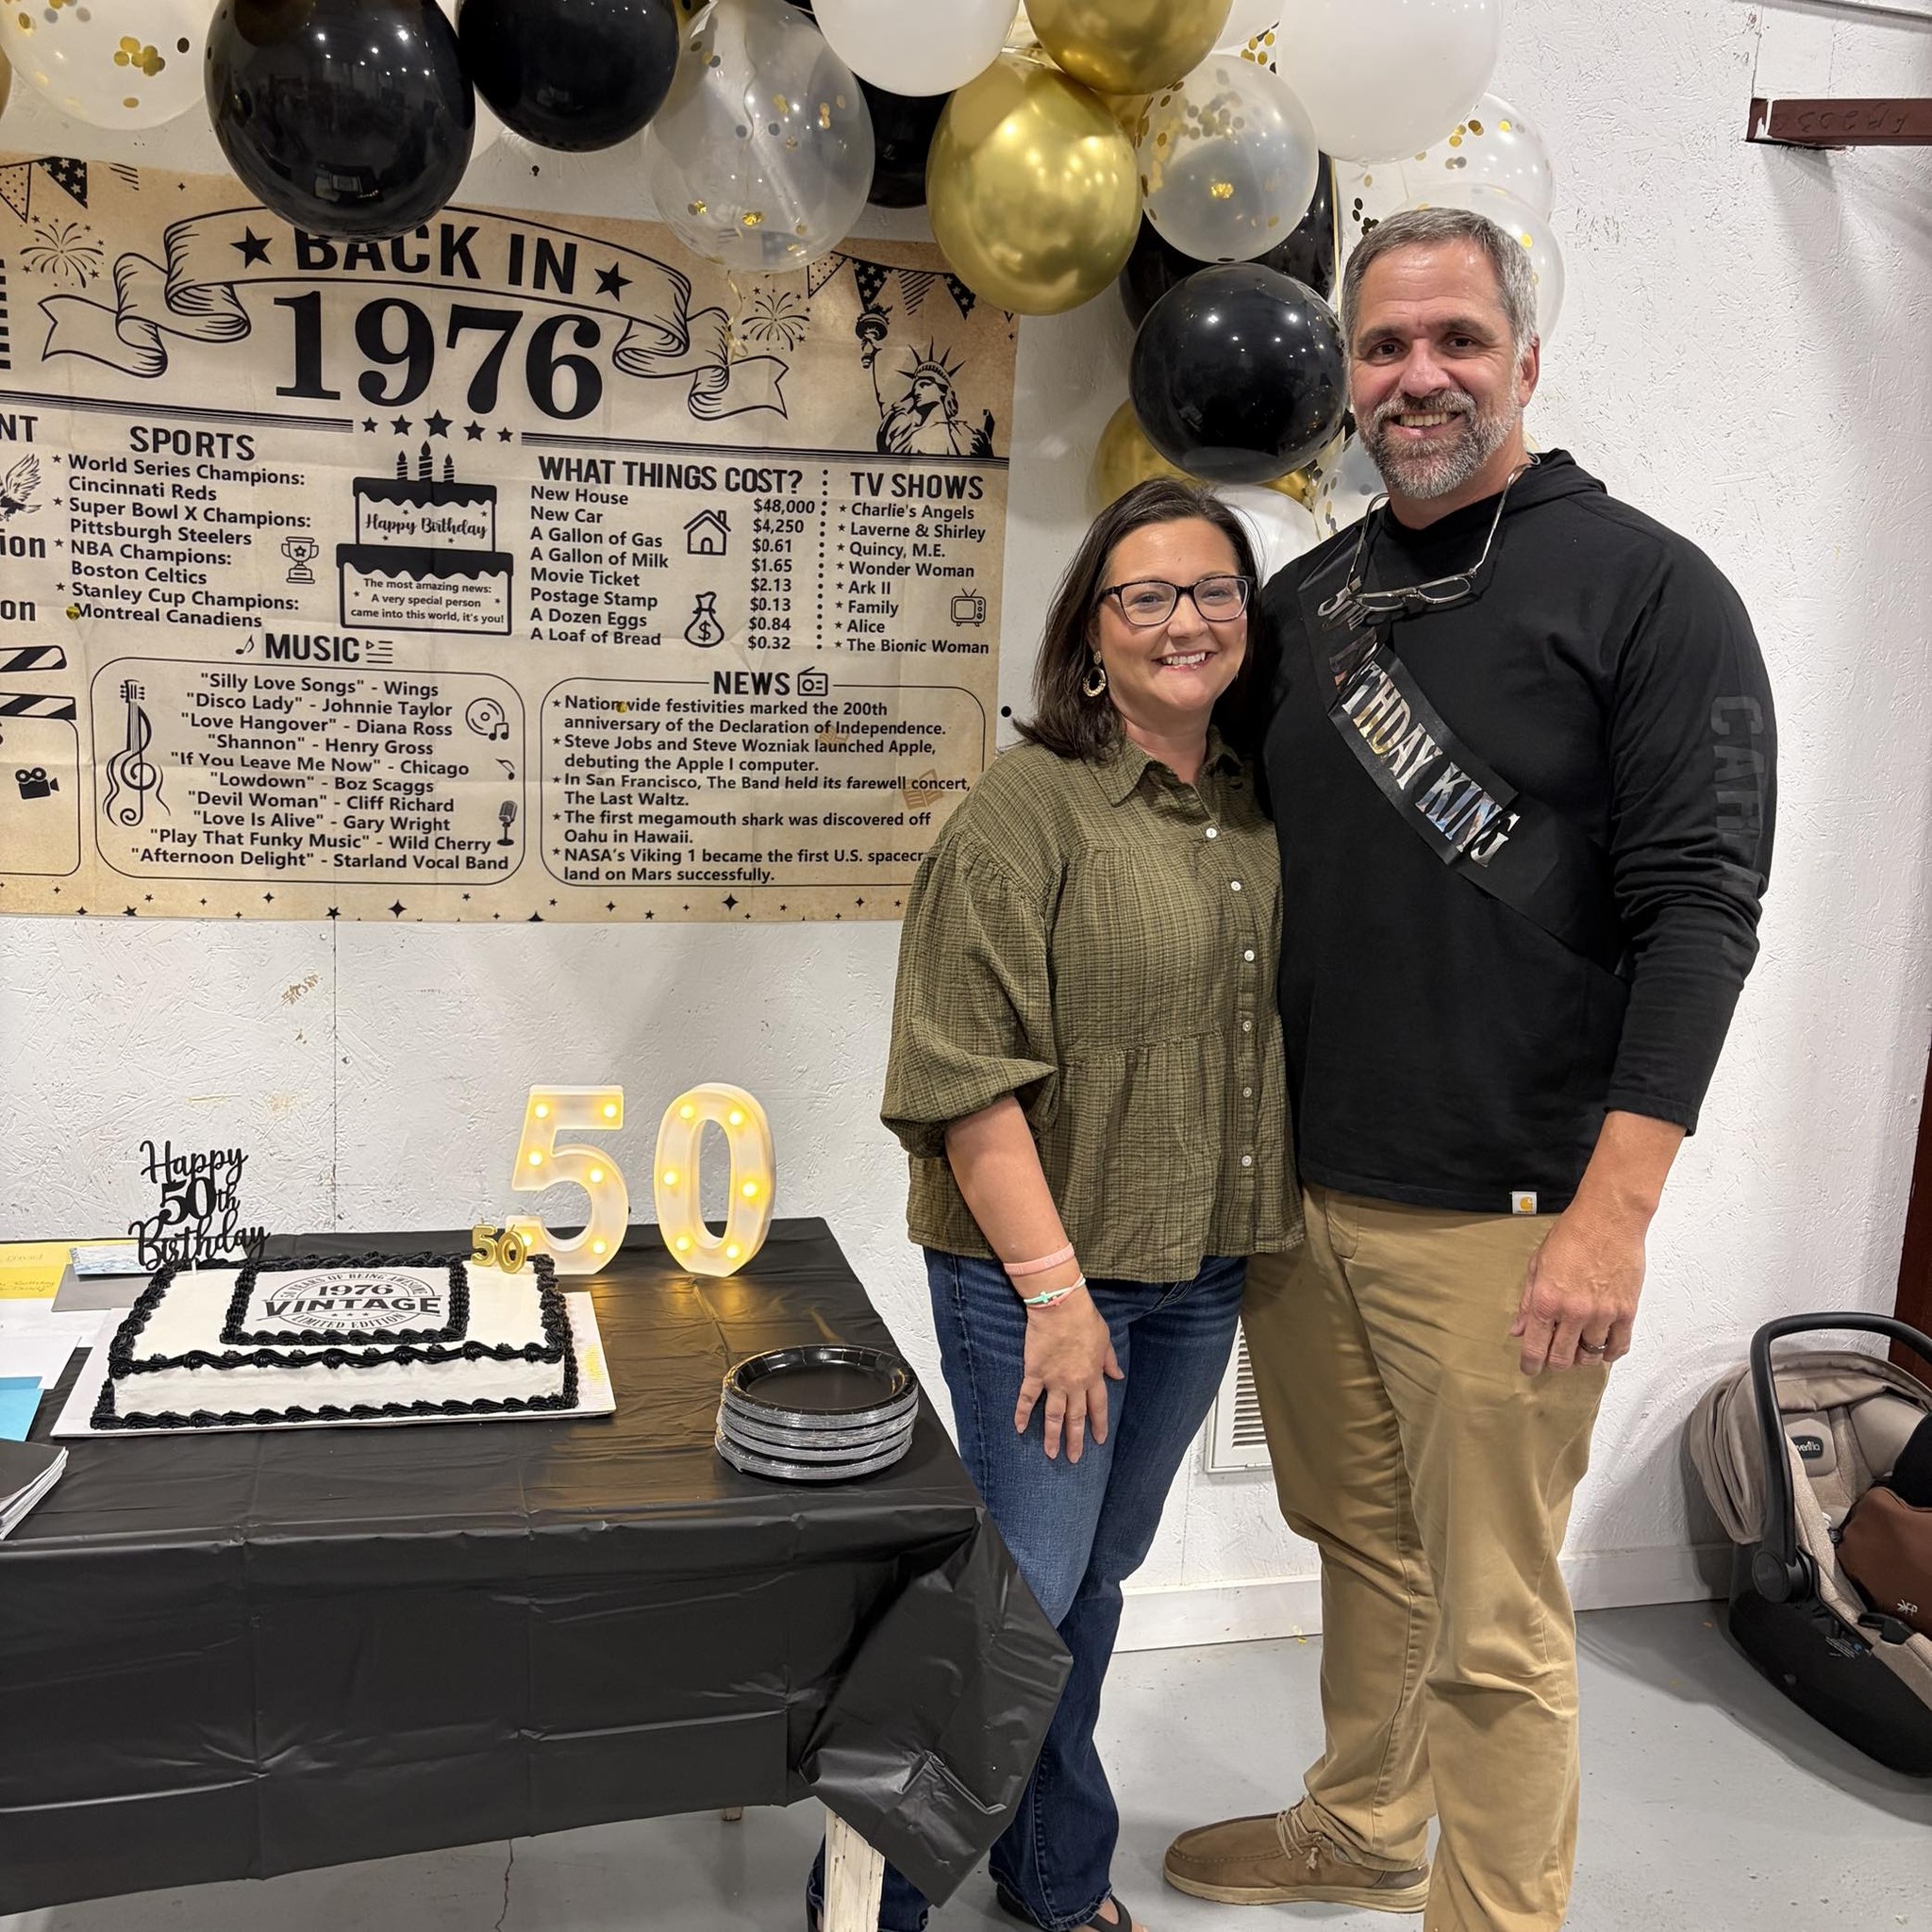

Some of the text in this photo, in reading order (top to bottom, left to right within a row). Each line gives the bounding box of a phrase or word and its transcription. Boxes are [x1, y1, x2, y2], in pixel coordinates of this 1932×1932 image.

[293, 223, 578, 295] BACK IN
[273, 290, 604, 420] 1976
[128, 425, 256, 462] SPORTS
[67, 453, 306, 488] World Series Champions:
[537, 455, 804, 495] WHAT THINGS COST?
[68, 475, 218, 502] Cincinnati Reds
[530, 484, 629, 507] New House
[849, 471, 985, 501] TV SHOWS
[68, 496, 311, 530] Super Bowl X Champions:
[530, 505, 605, 525] New Car
[753, 496, 816, 516] $48,000
[850, 501, 975, 524] Charlie's Angels
[70, 517, 253, 546] Pittsburgh Steelers
[365, 512, 488, 541] Happy Birthday
[529, 525, 663, 549] A Gallon of Gas
[752, 516, 805, 536] $4,250
[850, 521, 987, 544] Laverne & Shirley
[70, 538, 115, 558] NBA
[119, 542, 232, 567] Champions:
[529, 545, 670, 569] A Gallon of Milk
[751, 536, 792, 555] $0.61
[848, 541, 946, 561] Quincy, M.E.
[71, 559, 208, 586] Boston Celtics
[530, 566, 641, 588] Movie Ticket
[751, 557, 793, 575] $1.65
[848, 559, 975, 578] Wonder Woman
[71, 580, 300, 612] Stanley Cup Champions:
[362, 577, 492, 595] The most amazing news:
[750, 575, 792, 594] $2.13
[847, 579, 891, 595] Ark II
[370, 592, 482, 609] A very special person
[530, 586, 658, 612] Postage Stamp
[749, 595, 791, 613] $0.13
[847, 599, 900, 619] Family
[165, 608, 263, 628] Canadiens
[350, 608, 505, 625] came into this world, it's you!
[529, 607, 648, 631] A Dozen Eggs
[747, 615, 792, 633] $0.84
[845, 618, 886, 634] Alice
[529, 626, 662, 646] A Loaf of Bread
[747, 634, 791, 652] $0.32
[845, 637, 990, 655] The Bionic Woman
[264, 632, 360, 664] MUSIC
[200, 672, 440, 701] "Silly Love Songs" Wings
[712, 670, 791, 697] NEWS
[180, 711, 454, 737] "Love Hangover" Diana Ross
[208, 733, 434, 758] "Shannon" Henry Gross
[563, 733, 937, 758] Steve Jobs and Steve Wozniak launched Apple,
[563, 752, 820, 775] debuting the Apple I computer.
[563, 790, 690, 807] The Last Waltz.
[563, 827, 694, 844] Oahu in Hawaii.
[130, 846, 509, 871] "Afternoon Delight" Starland Vocal Band
[563, 865, 775, 885] land on Mars successfully.
[139, 1140, 249, 1186] Happy
[505, 1082, 777, 1278] 50
[158, 1176, 242, 1225] 50th
[127, 1209, 272, 1271] Birthday
[471, 1224, 527, 1274] 50
[318, 1283, 394, 1296] 1976
[264, 1297, 441, 1318] VINTAGE
[291, 1312, 408, 1328] LIMITED EDITION
